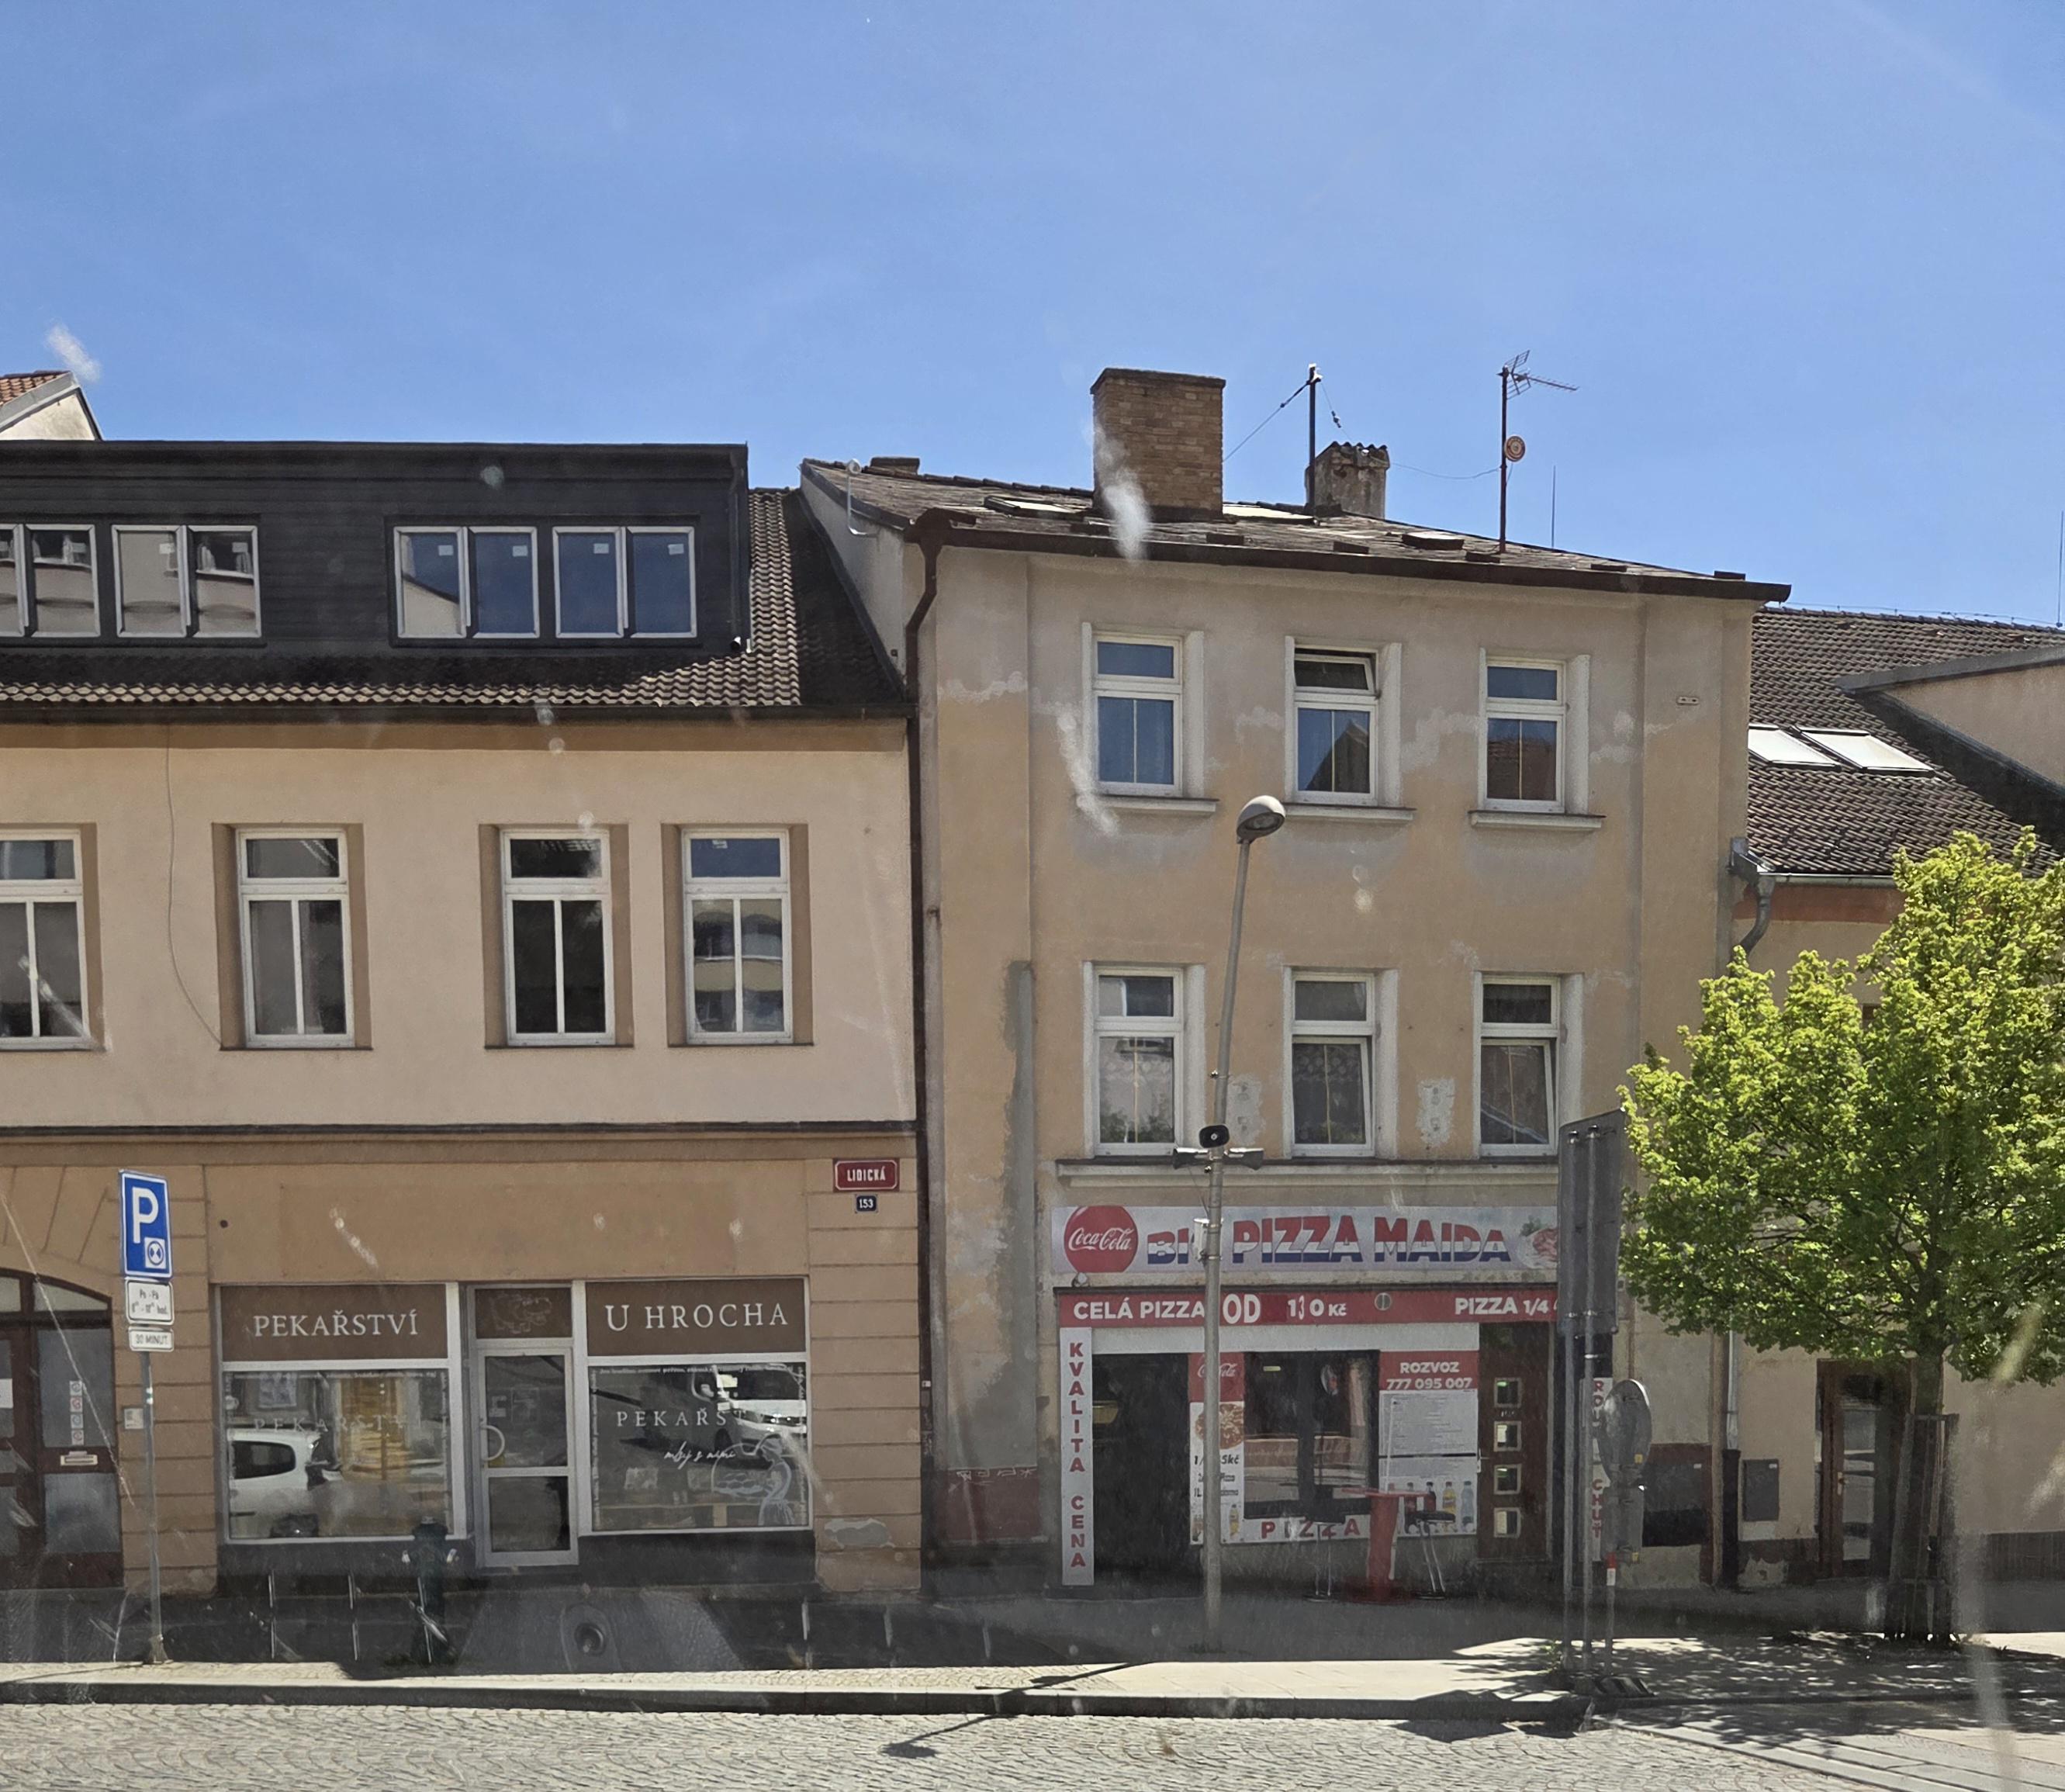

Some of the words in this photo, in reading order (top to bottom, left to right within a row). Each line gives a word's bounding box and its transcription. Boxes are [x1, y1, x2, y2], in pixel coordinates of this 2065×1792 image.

[846, 1165, 886, 1181] LIDICKÁ
[132, 1186, 159, 1244] P
[859, 1199, 873, 1209] 153
[1068, 1227, 1134, 1251] Coca-Cola
[1147, 1228, 1195, 1264] BI
[1233, 1216, 1363, 1264] PIZZA
[1374, 1216, 1511, 1262] MAIDA
[605, 1305, 629, 1331] U
[645, 1302, 788, 1329] HROCHA
[1074, 1298, 1133, 1319] CELÁ
[1140, 1301, 1205, 1318] PIZZA
[1223, 1293, 1261, 1324] OD
[1328, 1302, 1347, 1316] Kč
[1455, 1297, 1518, 1315] PIZZA
[1524, 1298, 1549, 1316] 1/4
[254, 1309, 418, 1337] PEKAŘSTVÍ
[1399, 1361, 1460, 1373] ROZVOZ
[1385, 1378, 1412, 1390] 777
[1414, 1378, 1443, 1389] 095
[1445, 1377, 1472, 1389] 007
[1068, 1342, 1085, 1472] KVALITA
[1070, 1495, 1086, 1568] CENA
